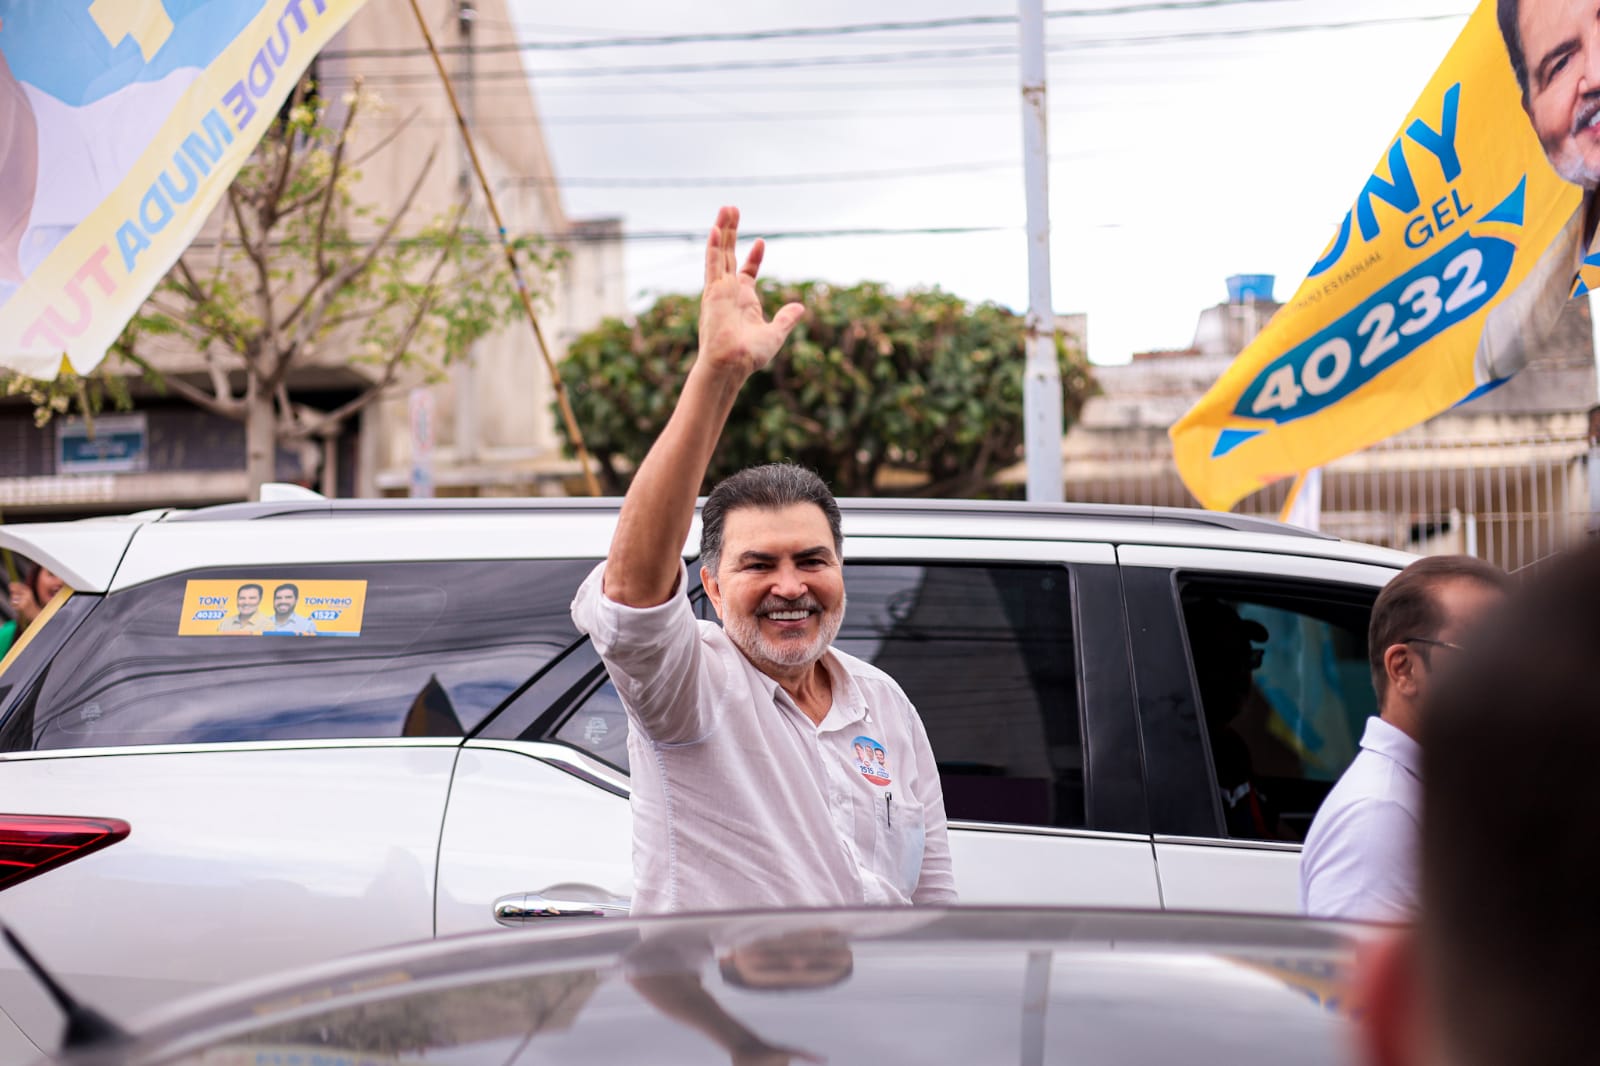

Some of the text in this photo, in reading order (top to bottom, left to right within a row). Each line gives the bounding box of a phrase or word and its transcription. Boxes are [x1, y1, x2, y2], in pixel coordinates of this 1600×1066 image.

[1404, 188, 1474, 249] GEL
[198, 596, 228, 606] TONY
[313, 610, 337, 620] 1522
